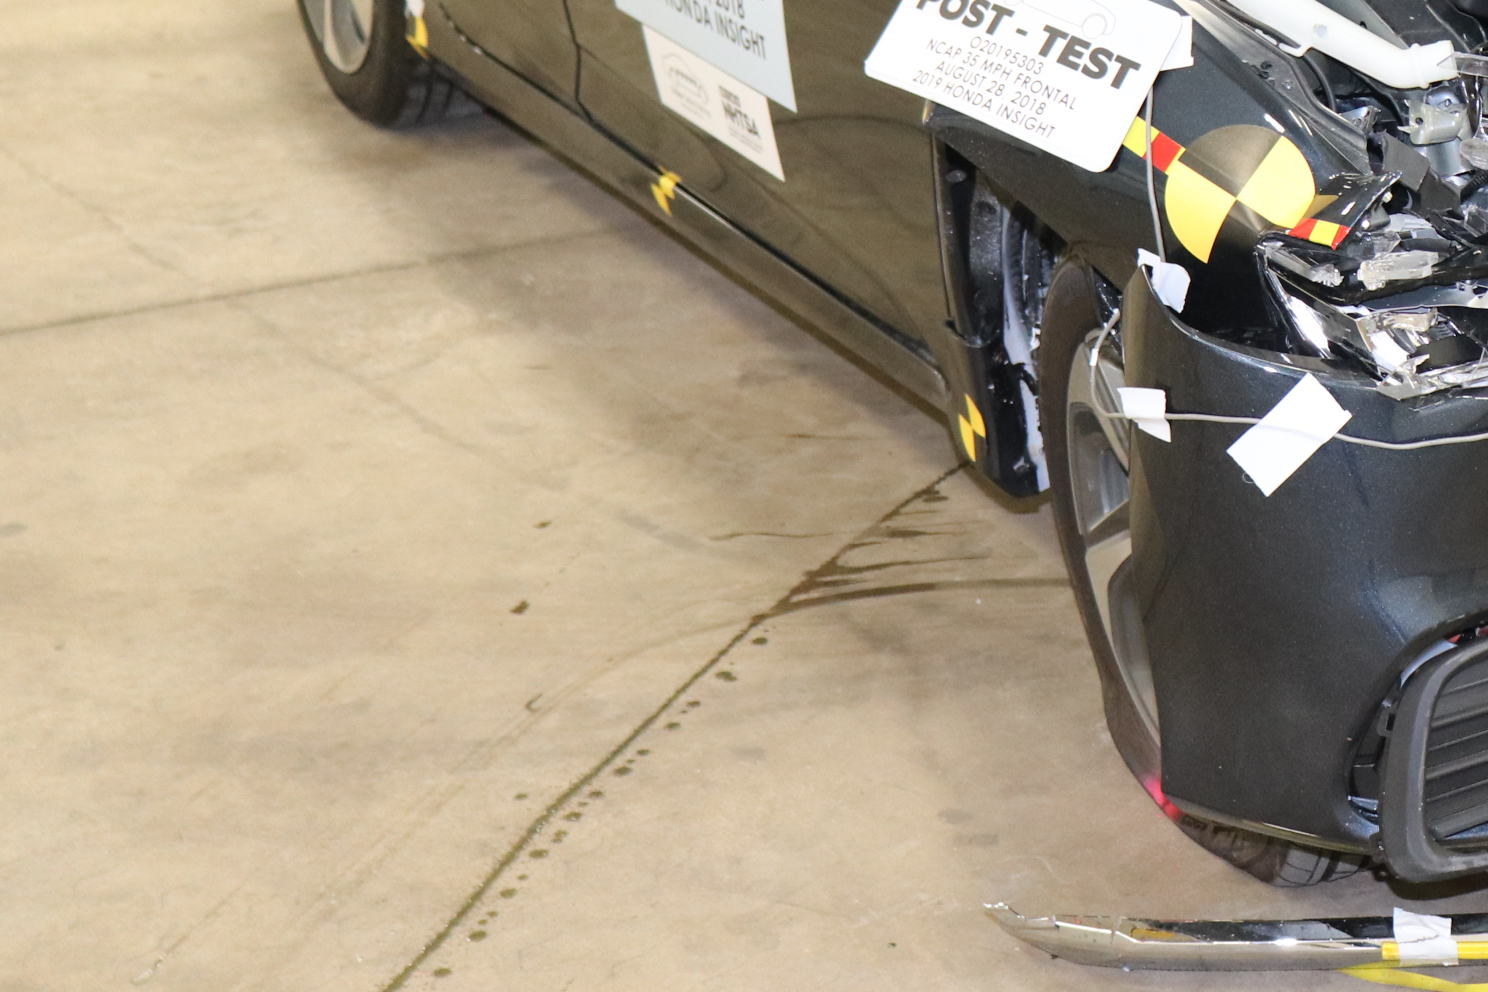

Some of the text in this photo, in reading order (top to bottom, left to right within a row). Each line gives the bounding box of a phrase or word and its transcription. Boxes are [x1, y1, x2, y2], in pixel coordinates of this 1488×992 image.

[714, 10, 766, 60] INSIGHT
[1038, 24, 1142, 90] TEST
[912, 69, 1056, 138] 2019 HONDA INSIGHT
[926, 38, 1077, 110] NCAP 35 MPH FRONTAL
[935, 60, 987, 88] AUGUST
[1010, 91, 1047, 115] 2018
[721, 99, 761, 139] NHTSA
